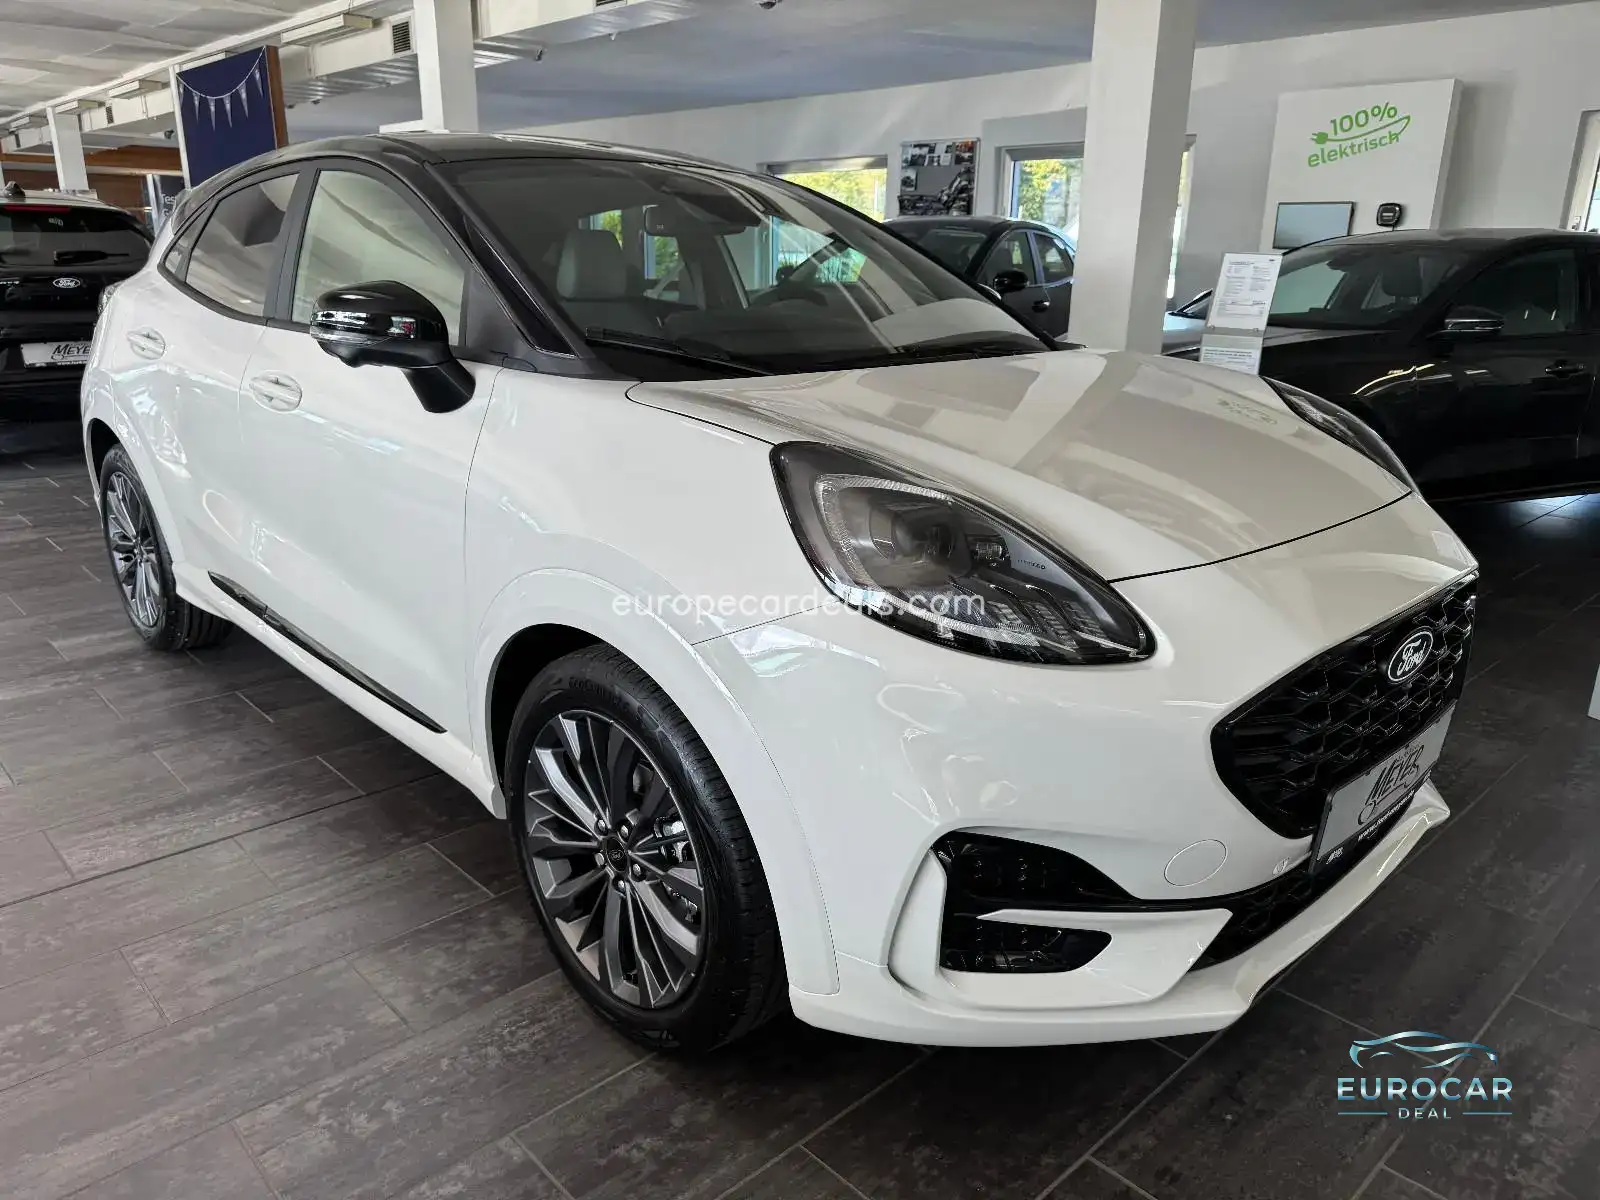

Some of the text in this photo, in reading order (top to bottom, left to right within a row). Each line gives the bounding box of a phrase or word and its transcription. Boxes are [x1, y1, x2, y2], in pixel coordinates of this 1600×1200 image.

[1330, 102, 1398, 136] 100%
[1307, 131, 1400, 167] elektrisch
[52, 344, 90, 355] MEYE
[1365, 744, 1425, 806] MEYER
